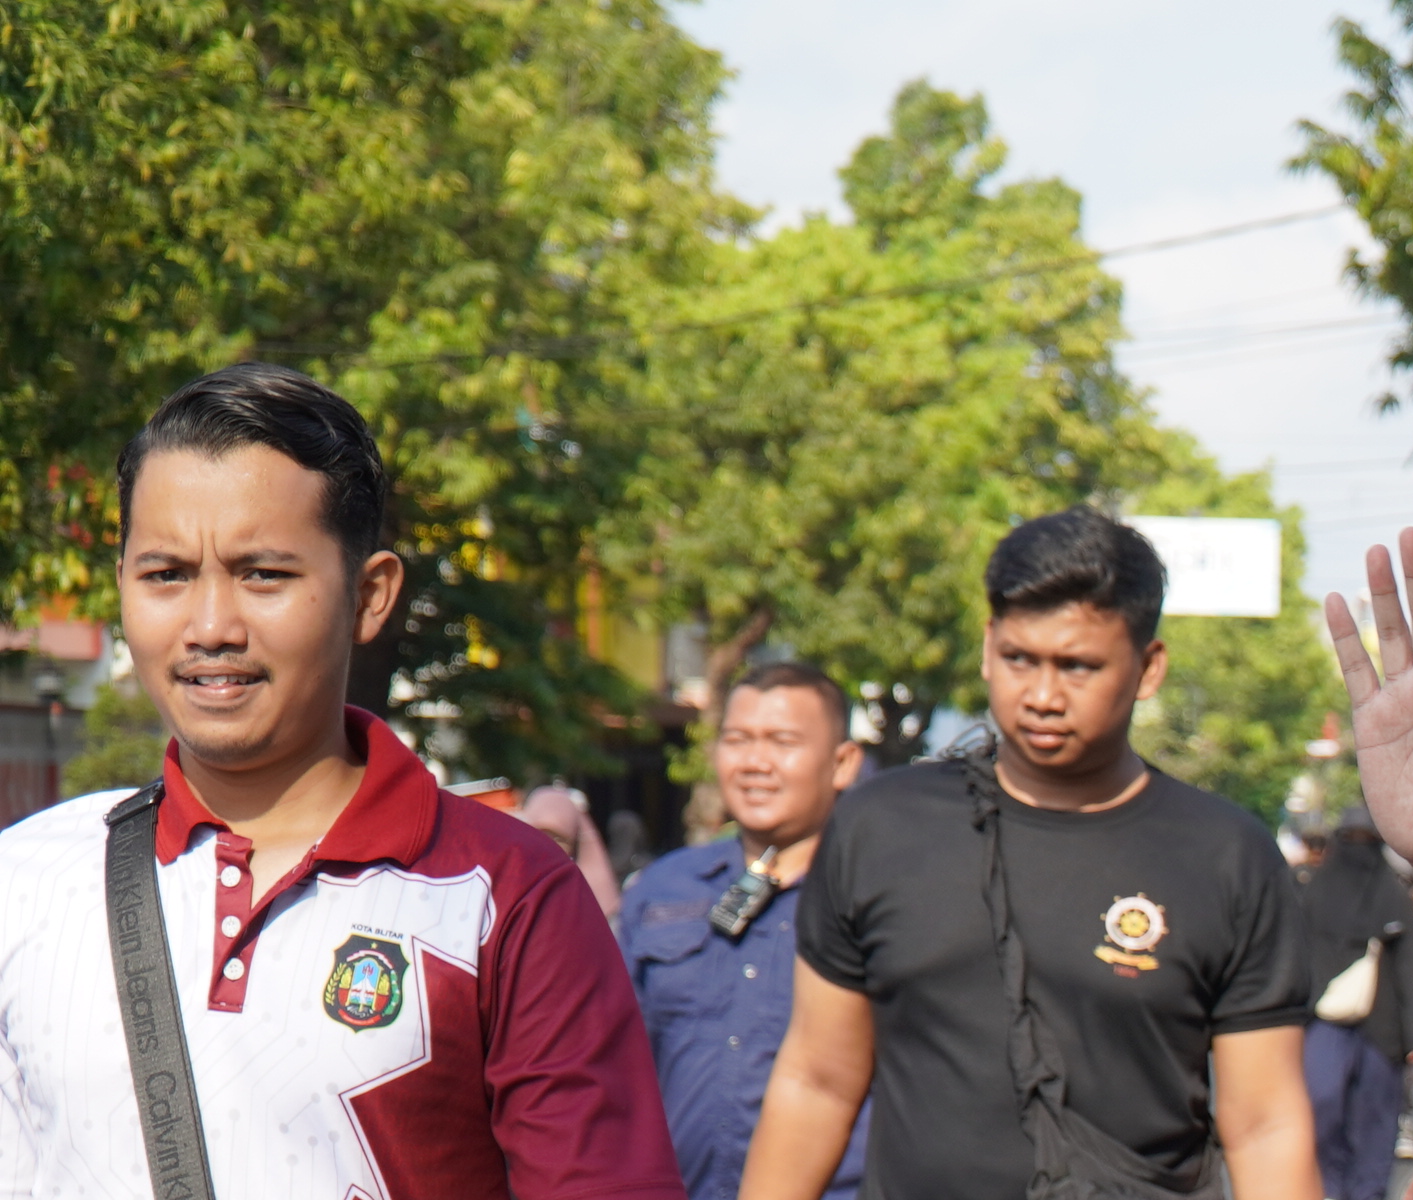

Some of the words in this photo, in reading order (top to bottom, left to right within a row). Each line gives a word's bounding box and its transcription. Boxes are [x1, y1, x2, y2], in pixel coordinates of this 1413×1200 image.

[351, 923, 373, 933] KOTA
[374, 928, 404, 940] BLITAR
[144, 1070, 187, 1173] Calvin
